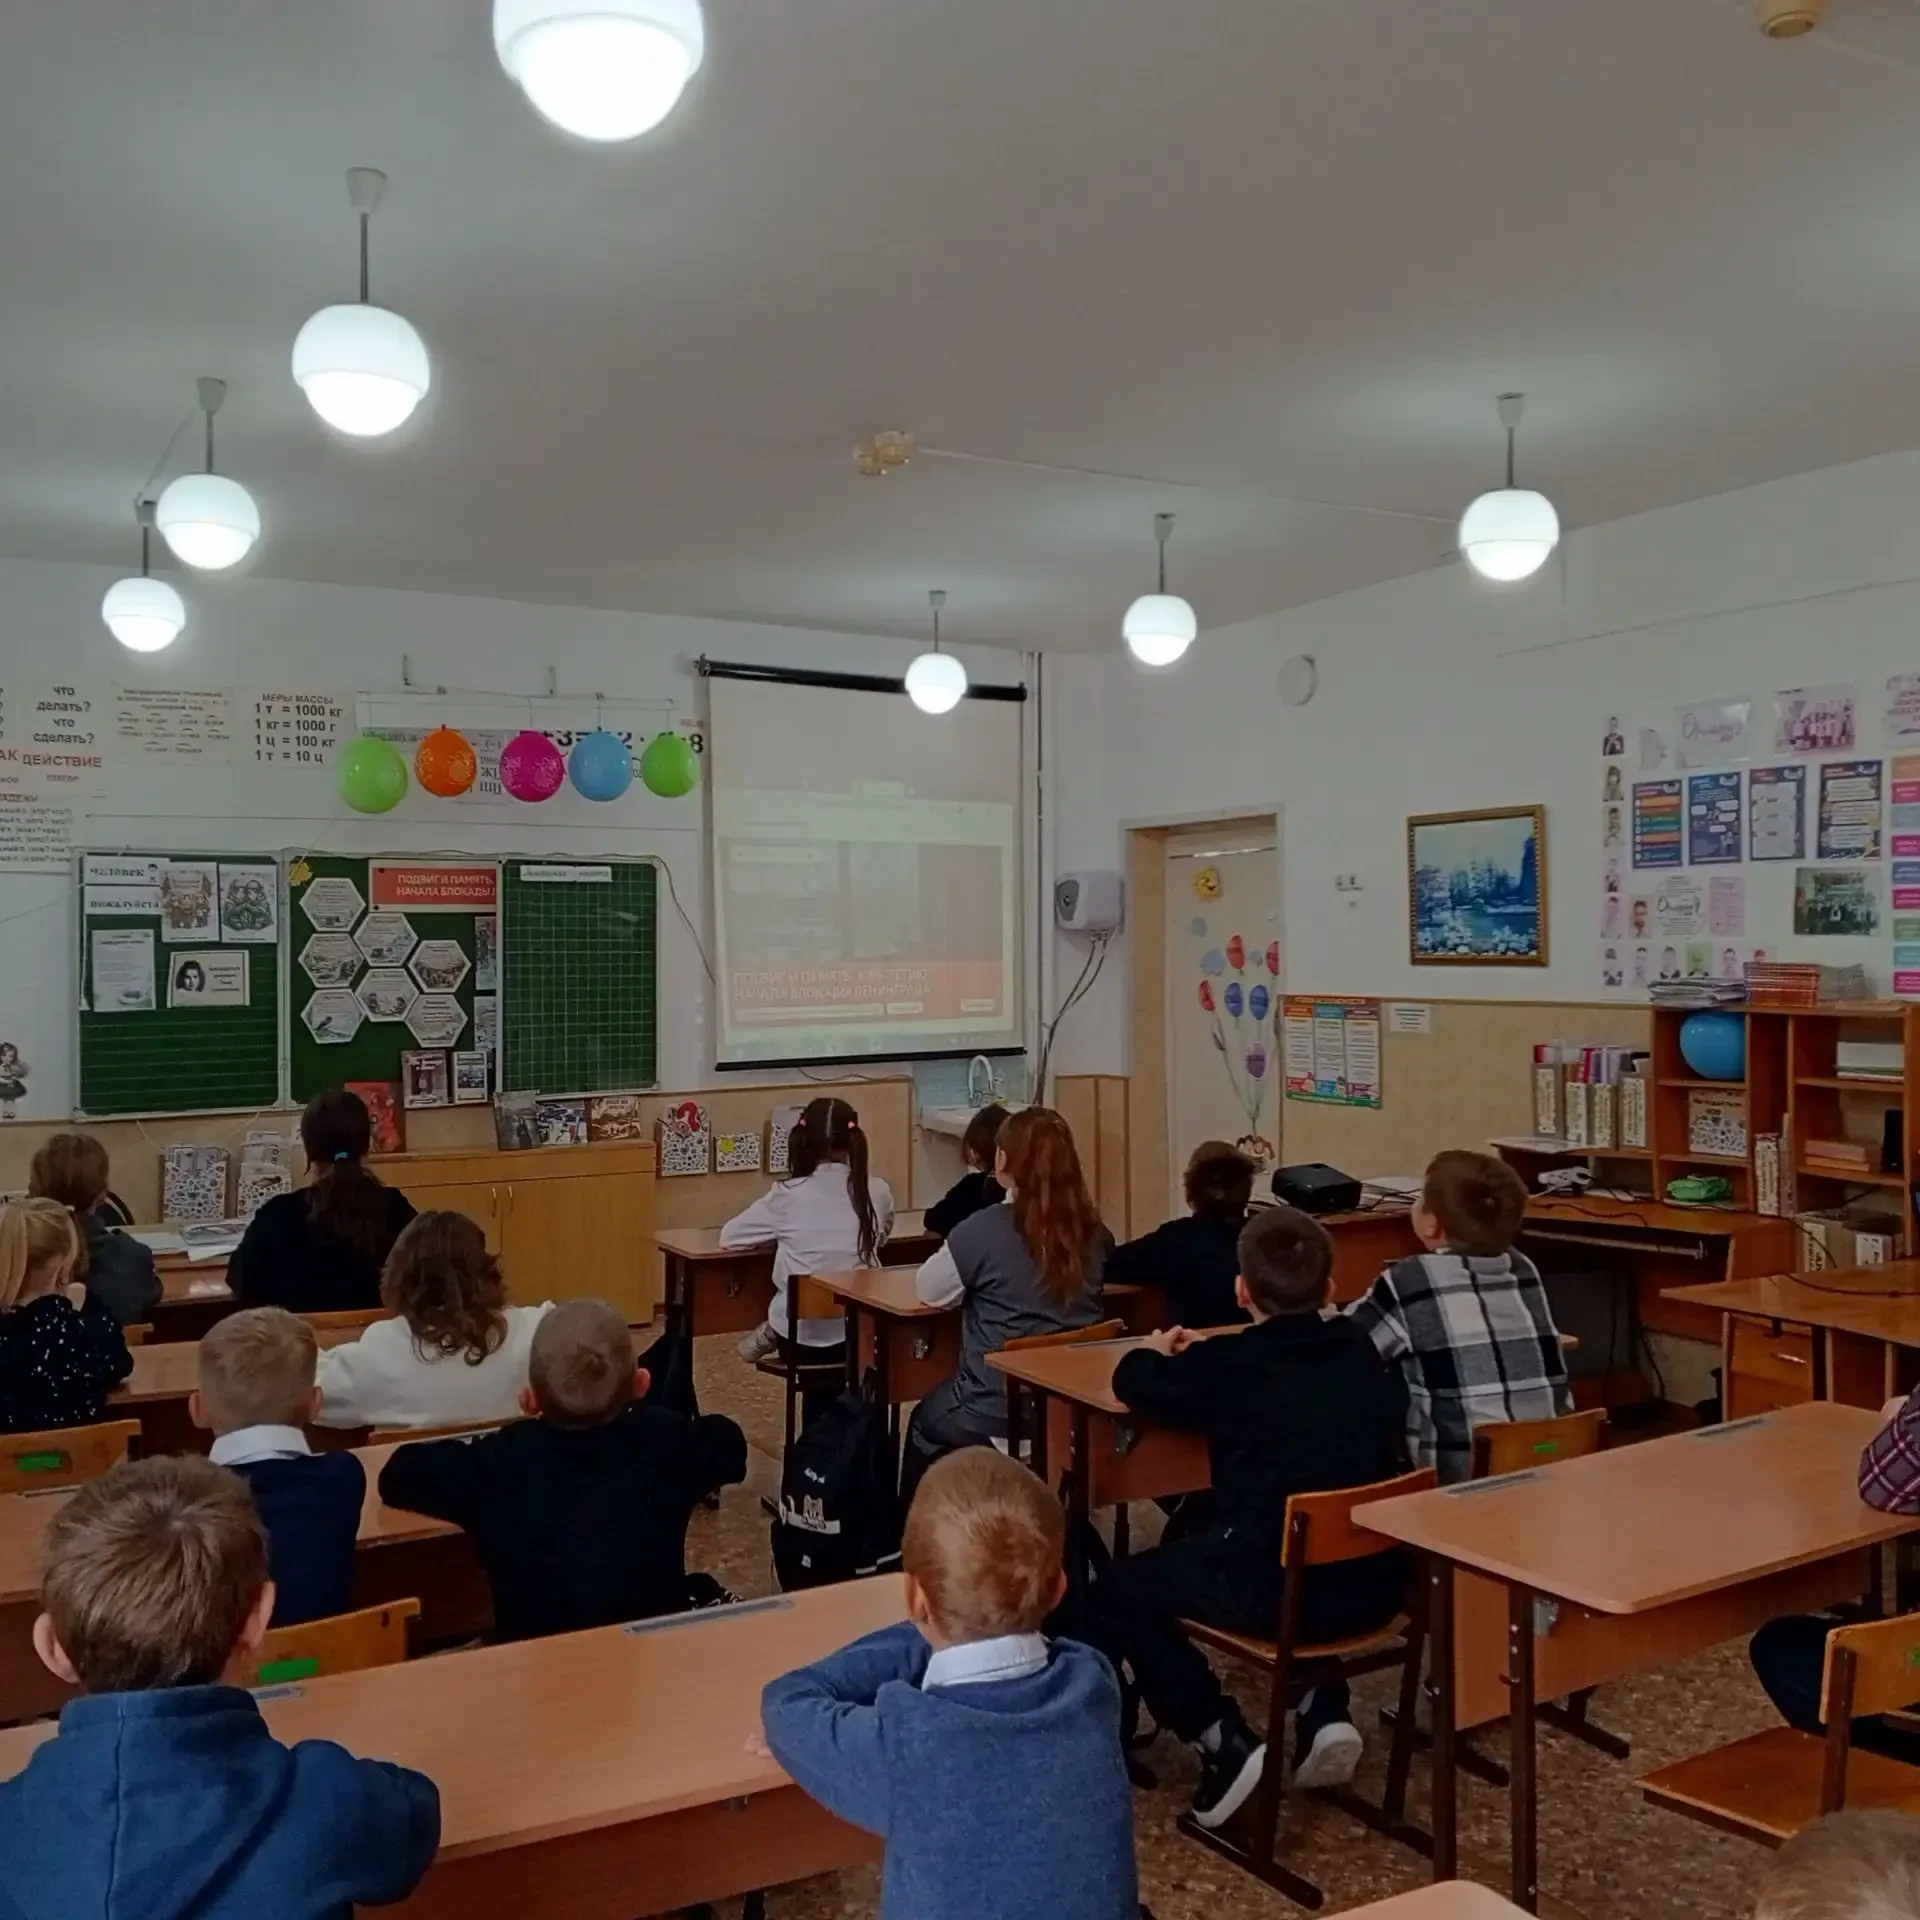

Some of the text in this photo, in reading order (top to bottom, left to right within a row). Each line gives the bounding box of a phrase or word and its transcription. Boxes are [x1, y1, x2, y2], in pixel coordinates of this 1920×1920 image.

[52, 686, 76, 696] что
[262, 693, 334, 704] МЕРЫ МАССЫ
[36, 700, 92, 713] делать?
[254, 702, 261, 714] 1
[265, 705, 273, 714] т
[295, 704, 326, 716] 1000
[329, 708, 343, 718] кг
[52, 717, 76, 728] что
[254, 717, 261, 730] 1
[266, 721, 280, 730] кг
[295, 719, 326, 731] 1000
[329, 723, 337, 733] г
[32, 732, 95, 744] сделать?
[254, 733, 261, 746] 1
[265, 736, 276, 748] ц
[295, 735, 318, 747] 100
[321, 738, 336, 748] кг
[22, 753, 103, 768] ДЕЙСТВИЕ
[254, 749, 261, 761] 1
[265, 751, 274, 761] т
[295, 750, 311, 762] 10
[314, 753, 324, 764] ц
[397, 873, 441, 885] ПОДВИГ
[441, 875, 449, 884] И
[396, 886, 439, 897] НАЧАЛА
[440, 886, 491, 897] БЛОКАДЫ
